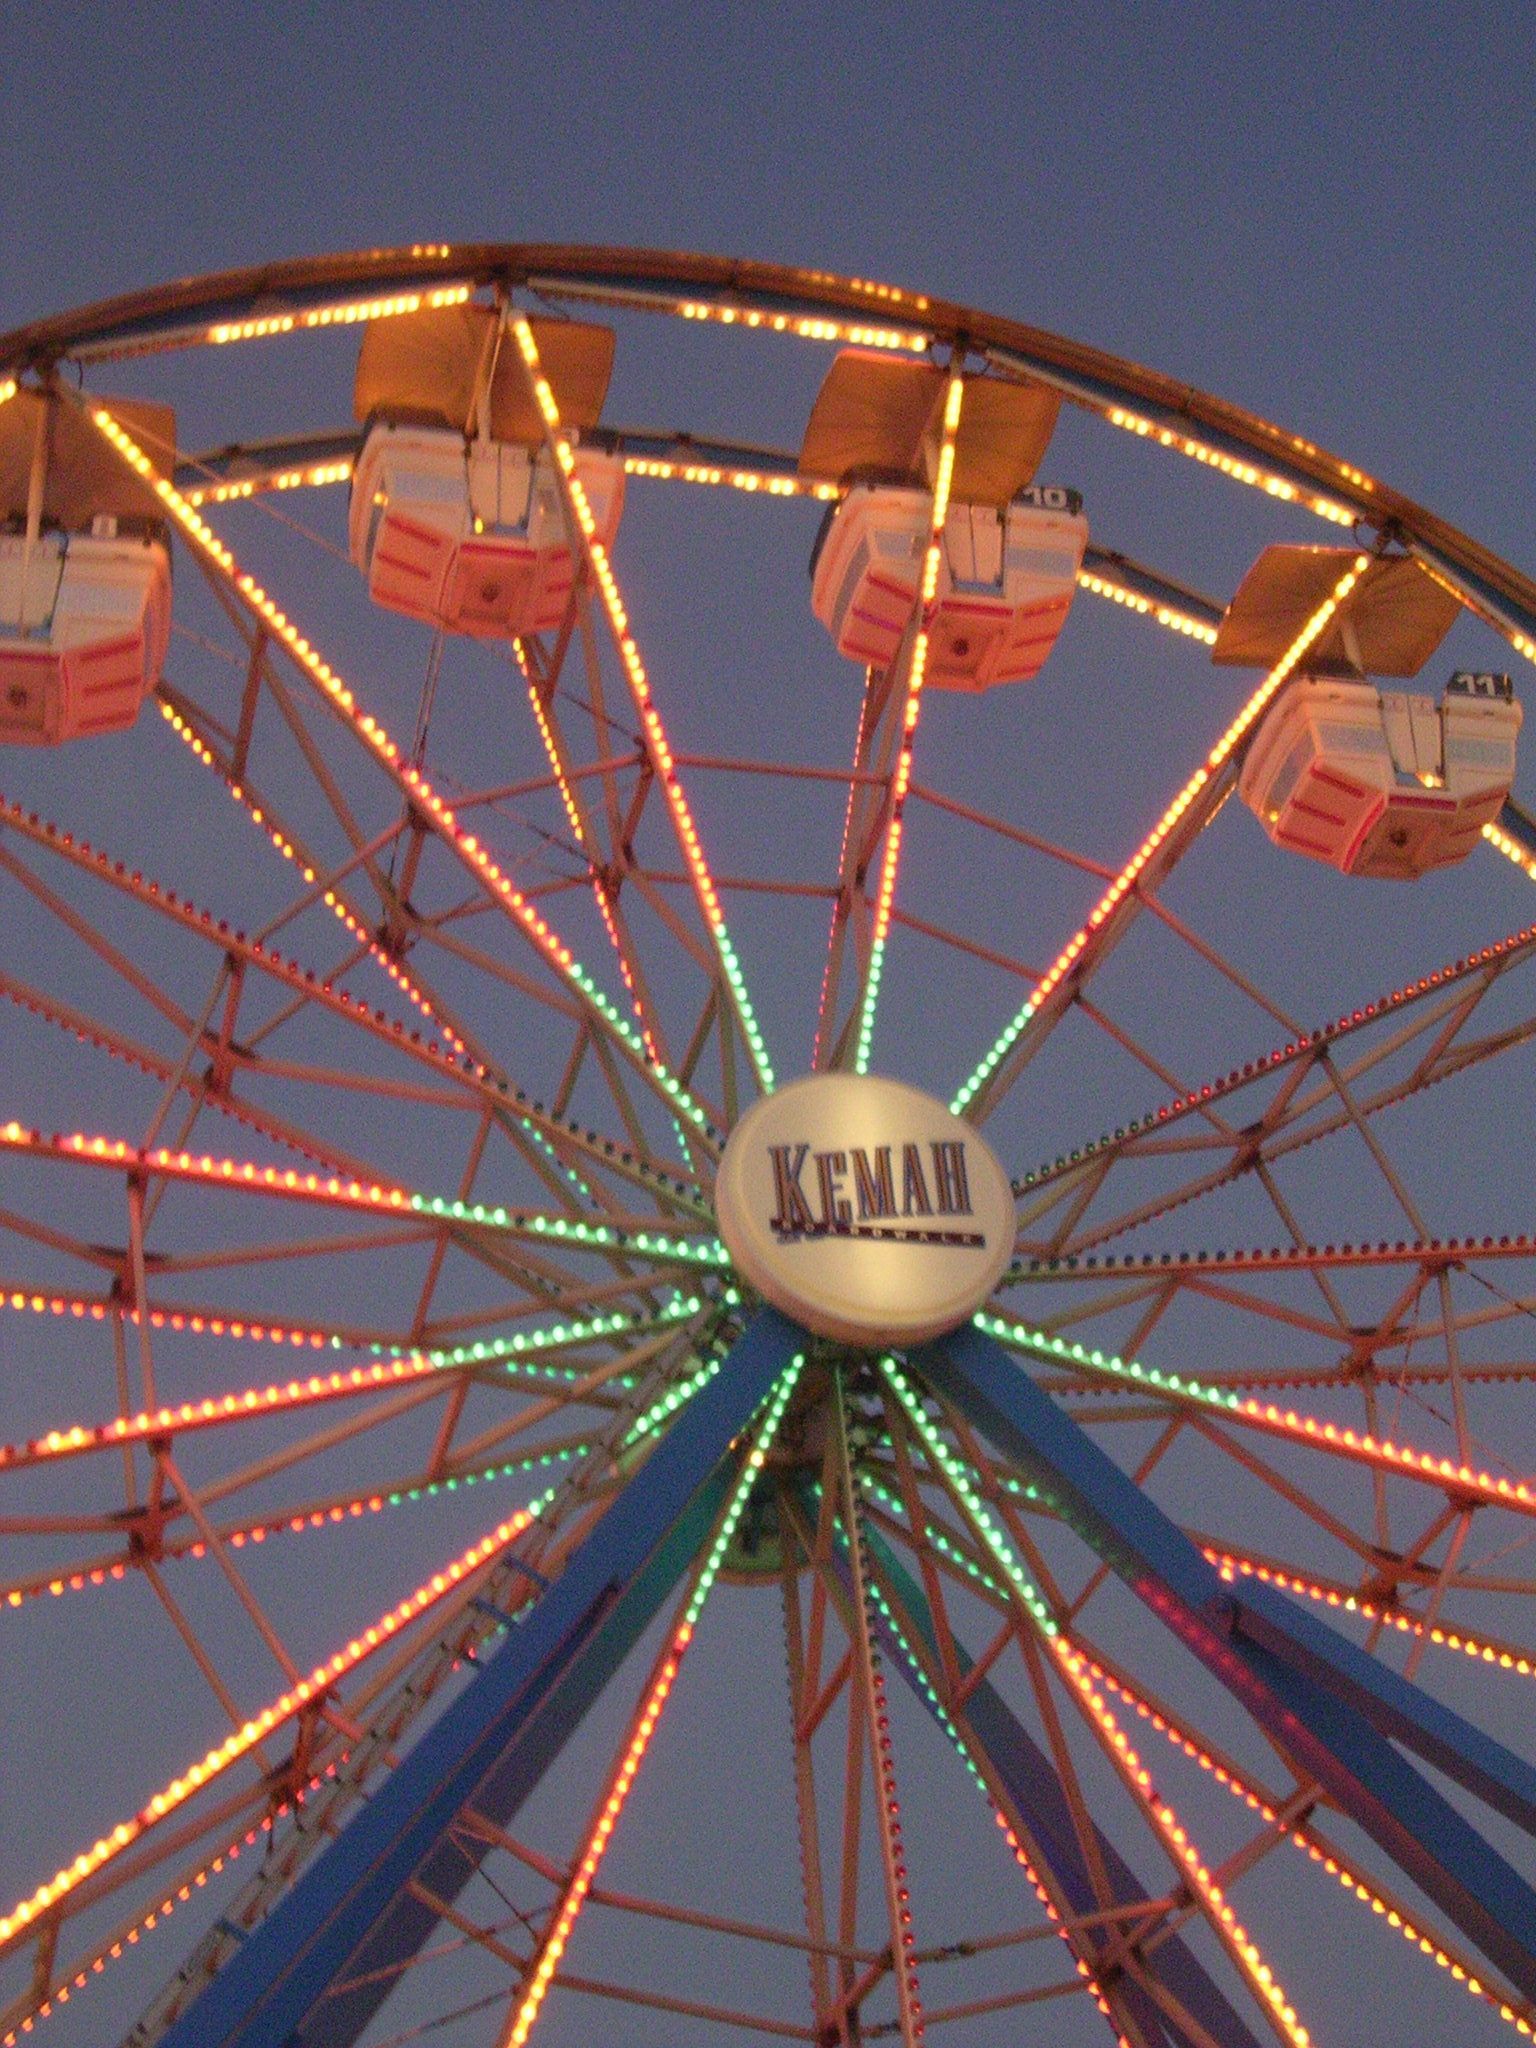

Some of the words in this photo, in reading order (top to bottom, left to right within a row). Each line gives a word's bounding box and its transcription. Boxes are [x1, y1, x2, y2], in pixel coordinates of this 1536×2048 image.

[1022, 486, 1068, 509] 10
[1457, 674, 1497, 698] 11
[767, 1141, 975, 1243] KEMAH
